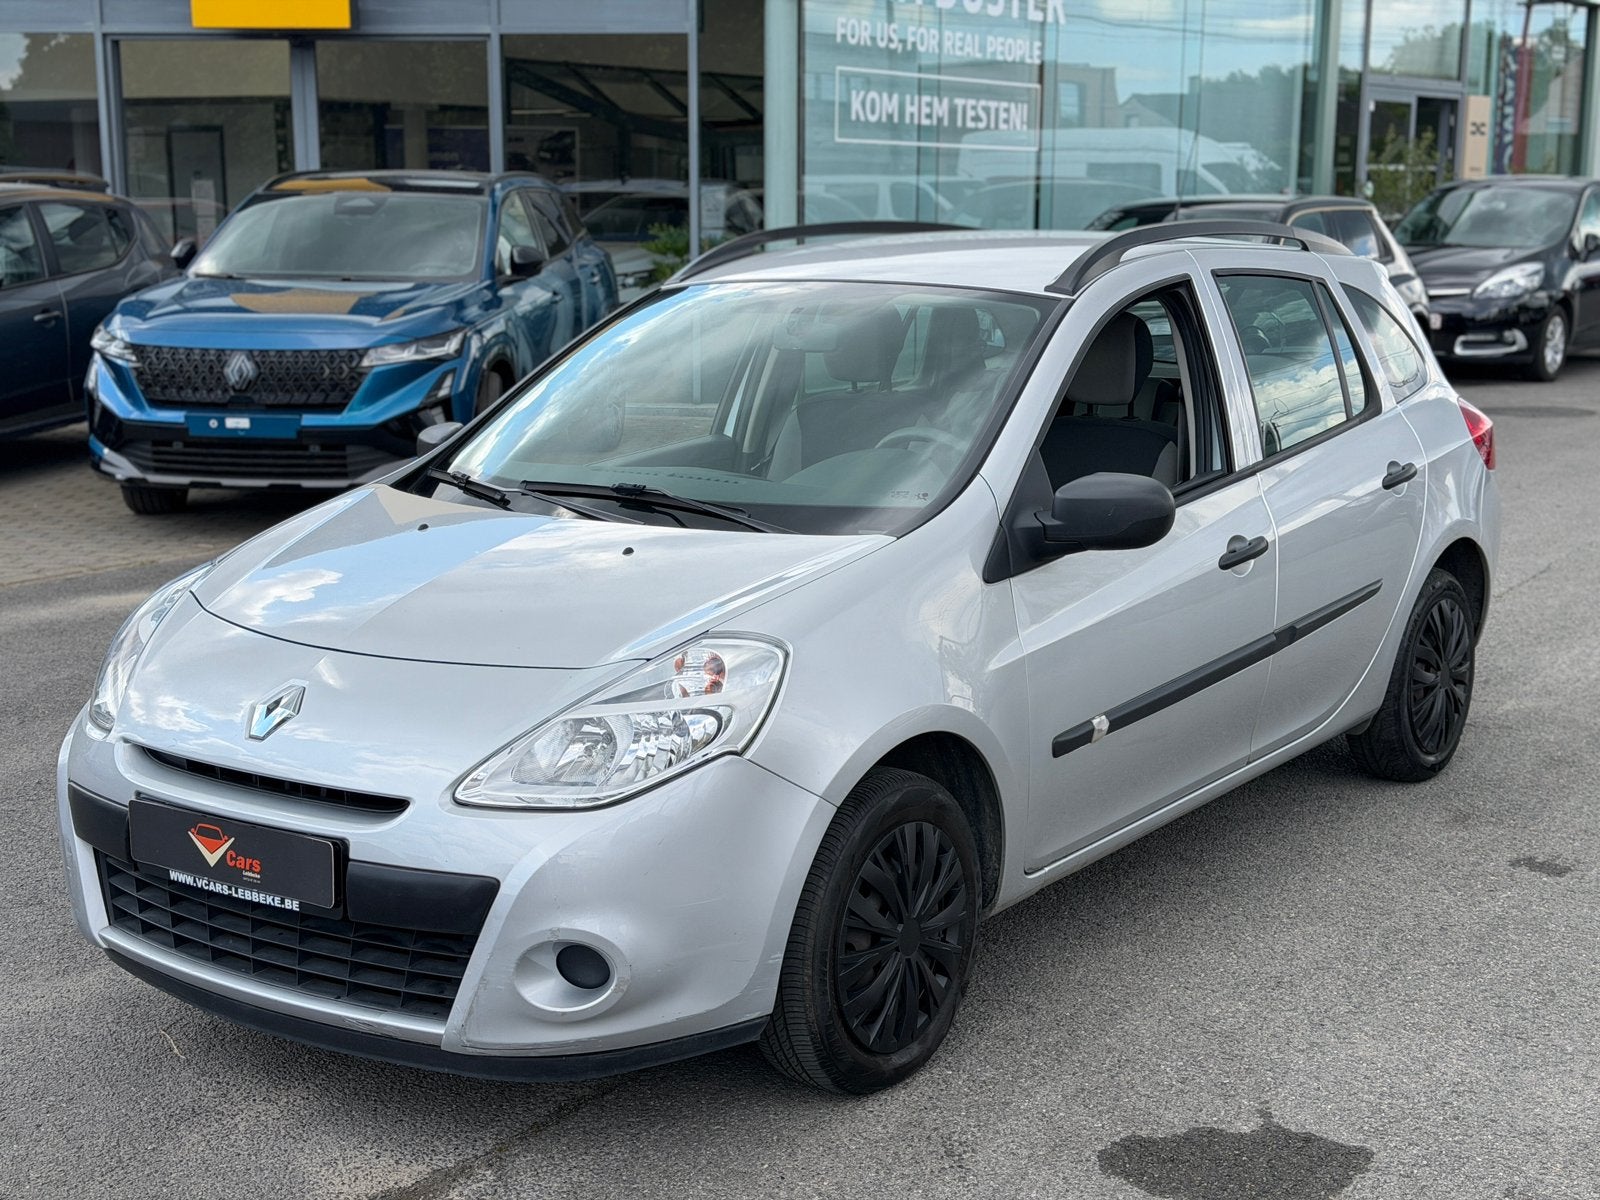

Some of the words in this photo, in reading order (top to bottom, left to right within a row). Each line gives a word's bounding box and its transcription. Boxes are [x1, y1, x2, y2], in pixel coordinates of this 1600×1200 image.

[836, 17, 871, 46] FOR
[876, 22, 902, 53] US,
[907, 26, 939, 54] FOR
[944, 31, 982, 58] REAL
[986, 37, 1042, 64] PEOPLE
[851, 89, 899, 124] KOM
[905, 94, 949, 127] HEM
[953, 98, 1028, 132] TESTEN!
[226, 850, 261, 873] Cars
[169, 869, 300, 912] WWW.VCARS-LEBBEKE.BE
